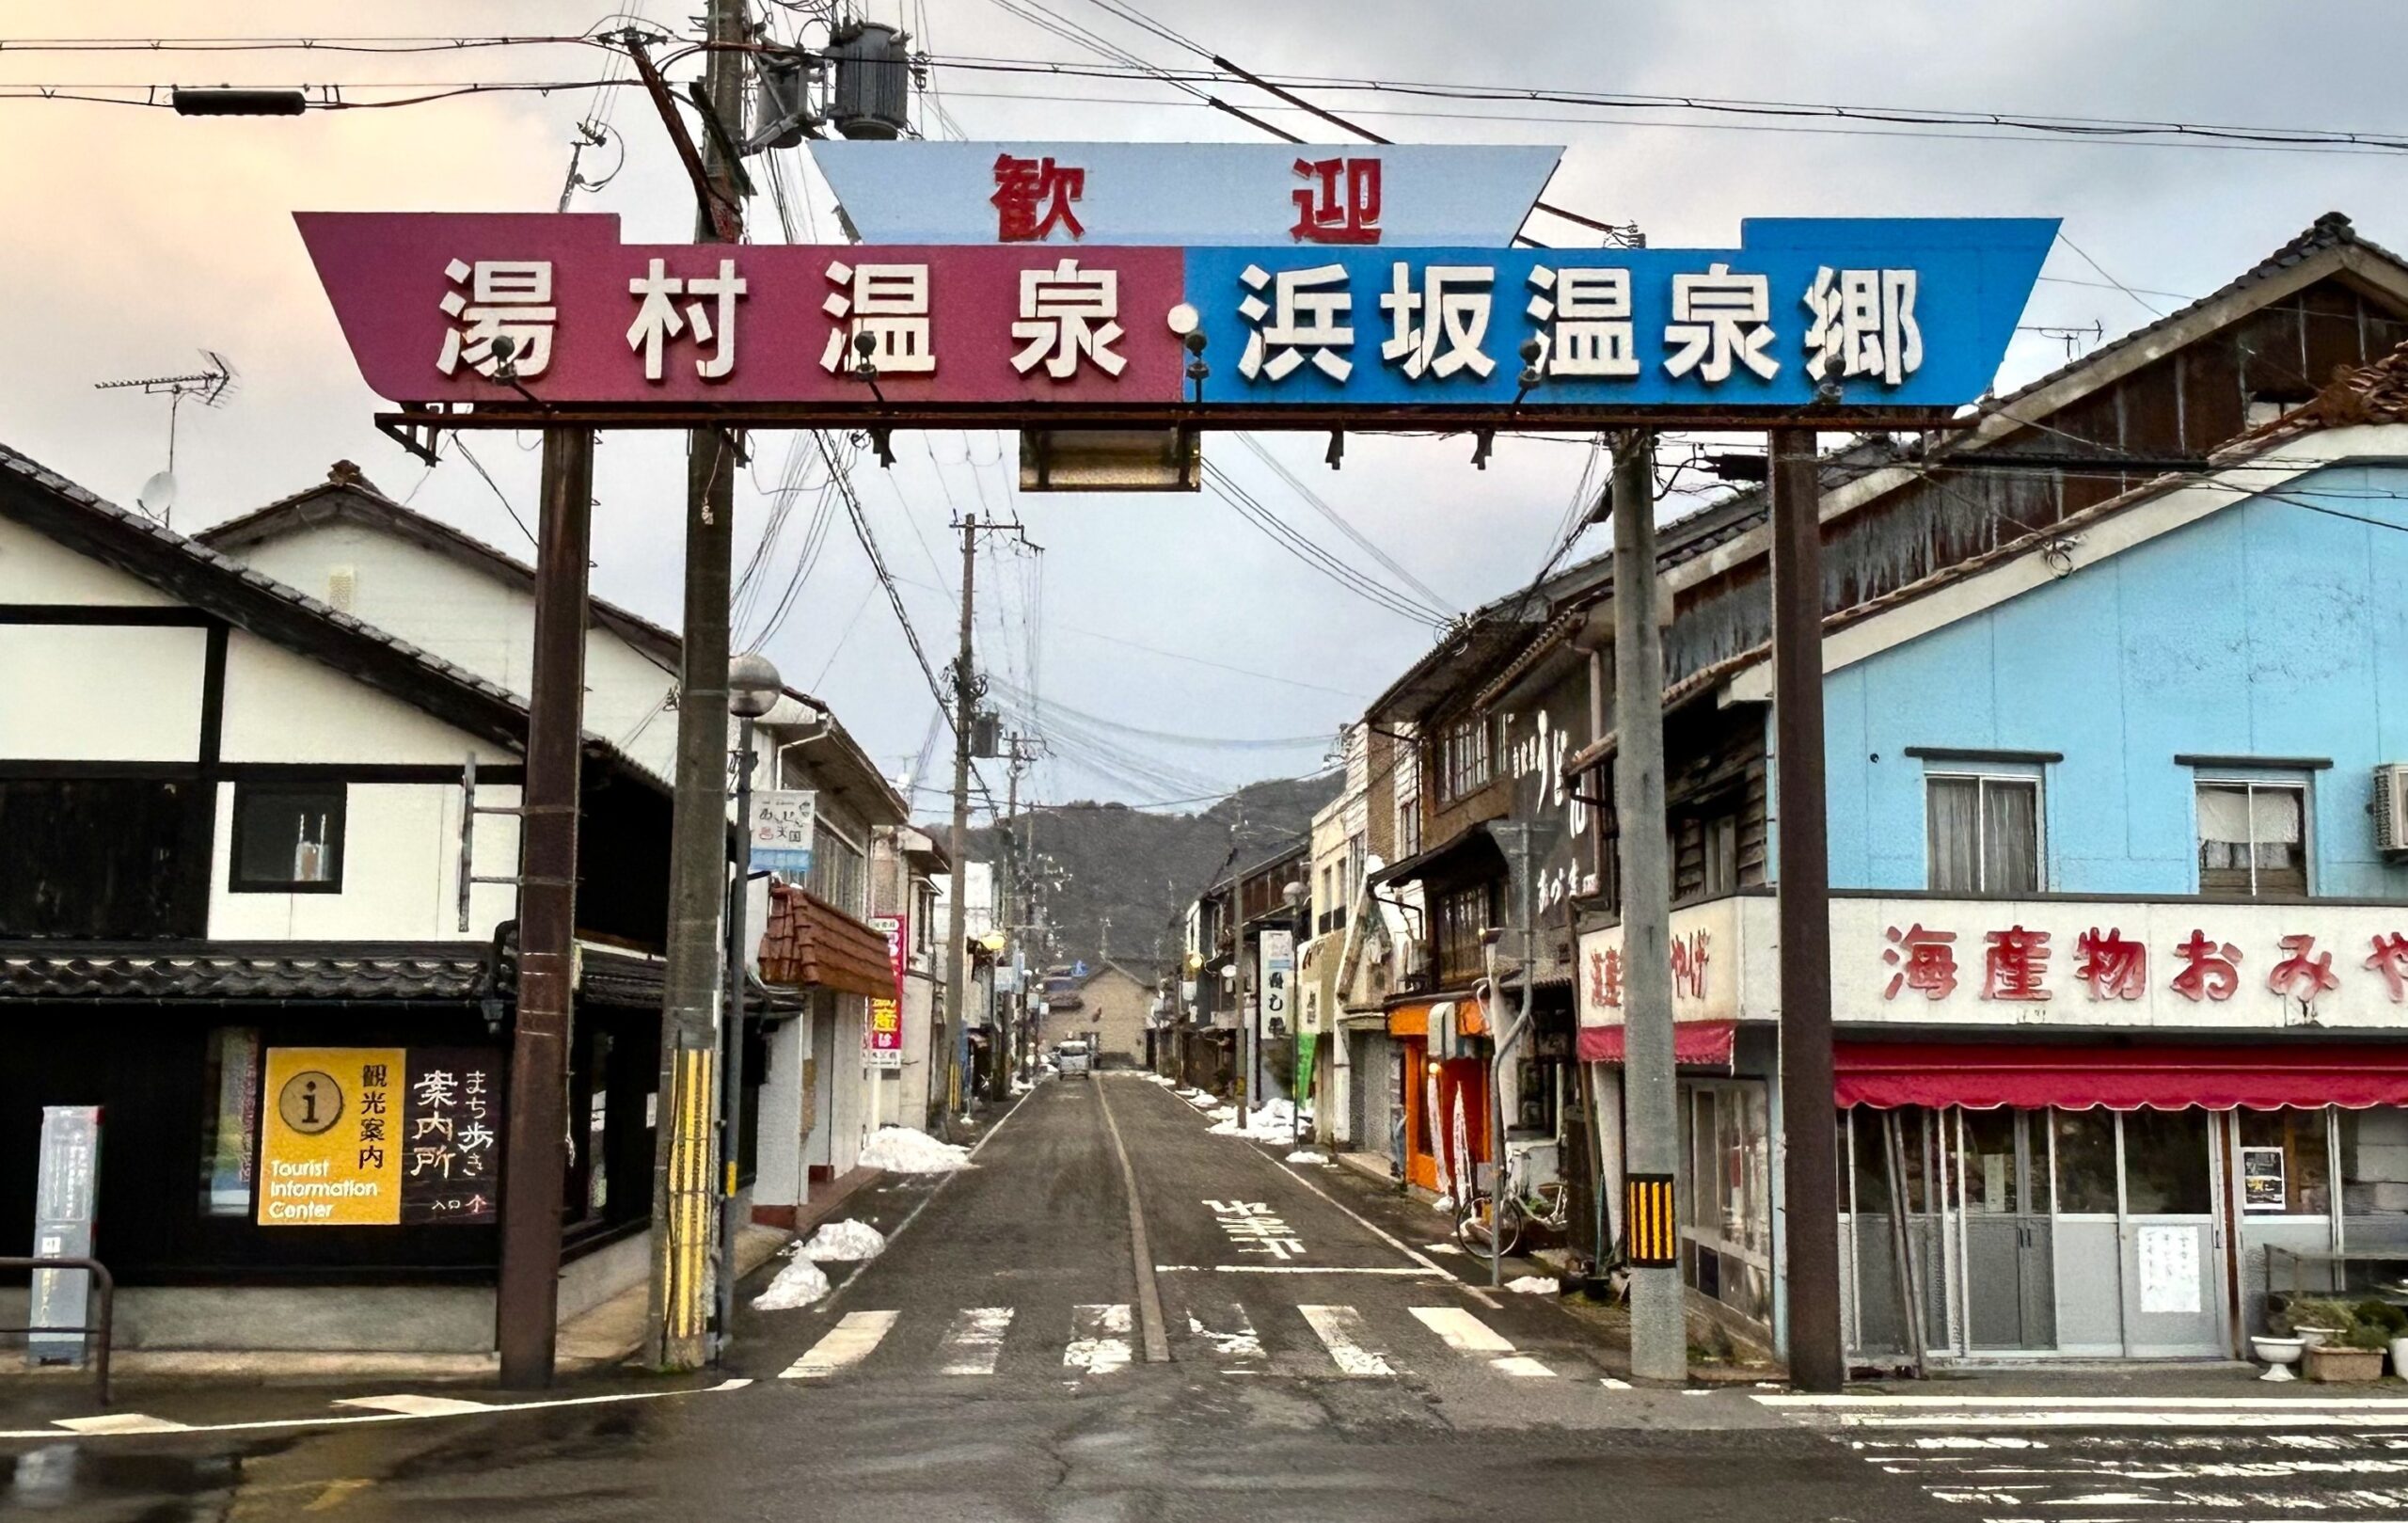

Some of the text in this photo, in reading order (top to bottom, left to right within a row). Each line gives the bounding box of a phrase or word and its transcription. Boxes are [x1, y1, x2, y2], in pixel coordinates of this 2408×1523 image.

[990, 152, 1382, 246] 歓迎
[358, 1064, 388, 1170] 観光案内
[410, 1070, 459, 1179] 案内所
[457, 1070, 495, 1177] まち歩き
[270, 1159, 330, 1178] Tourist
[270, 1179, 378, 1198] Information
[268, 1200, 335, 1220] Center
[431, 1199, 461, 1212] 入口
